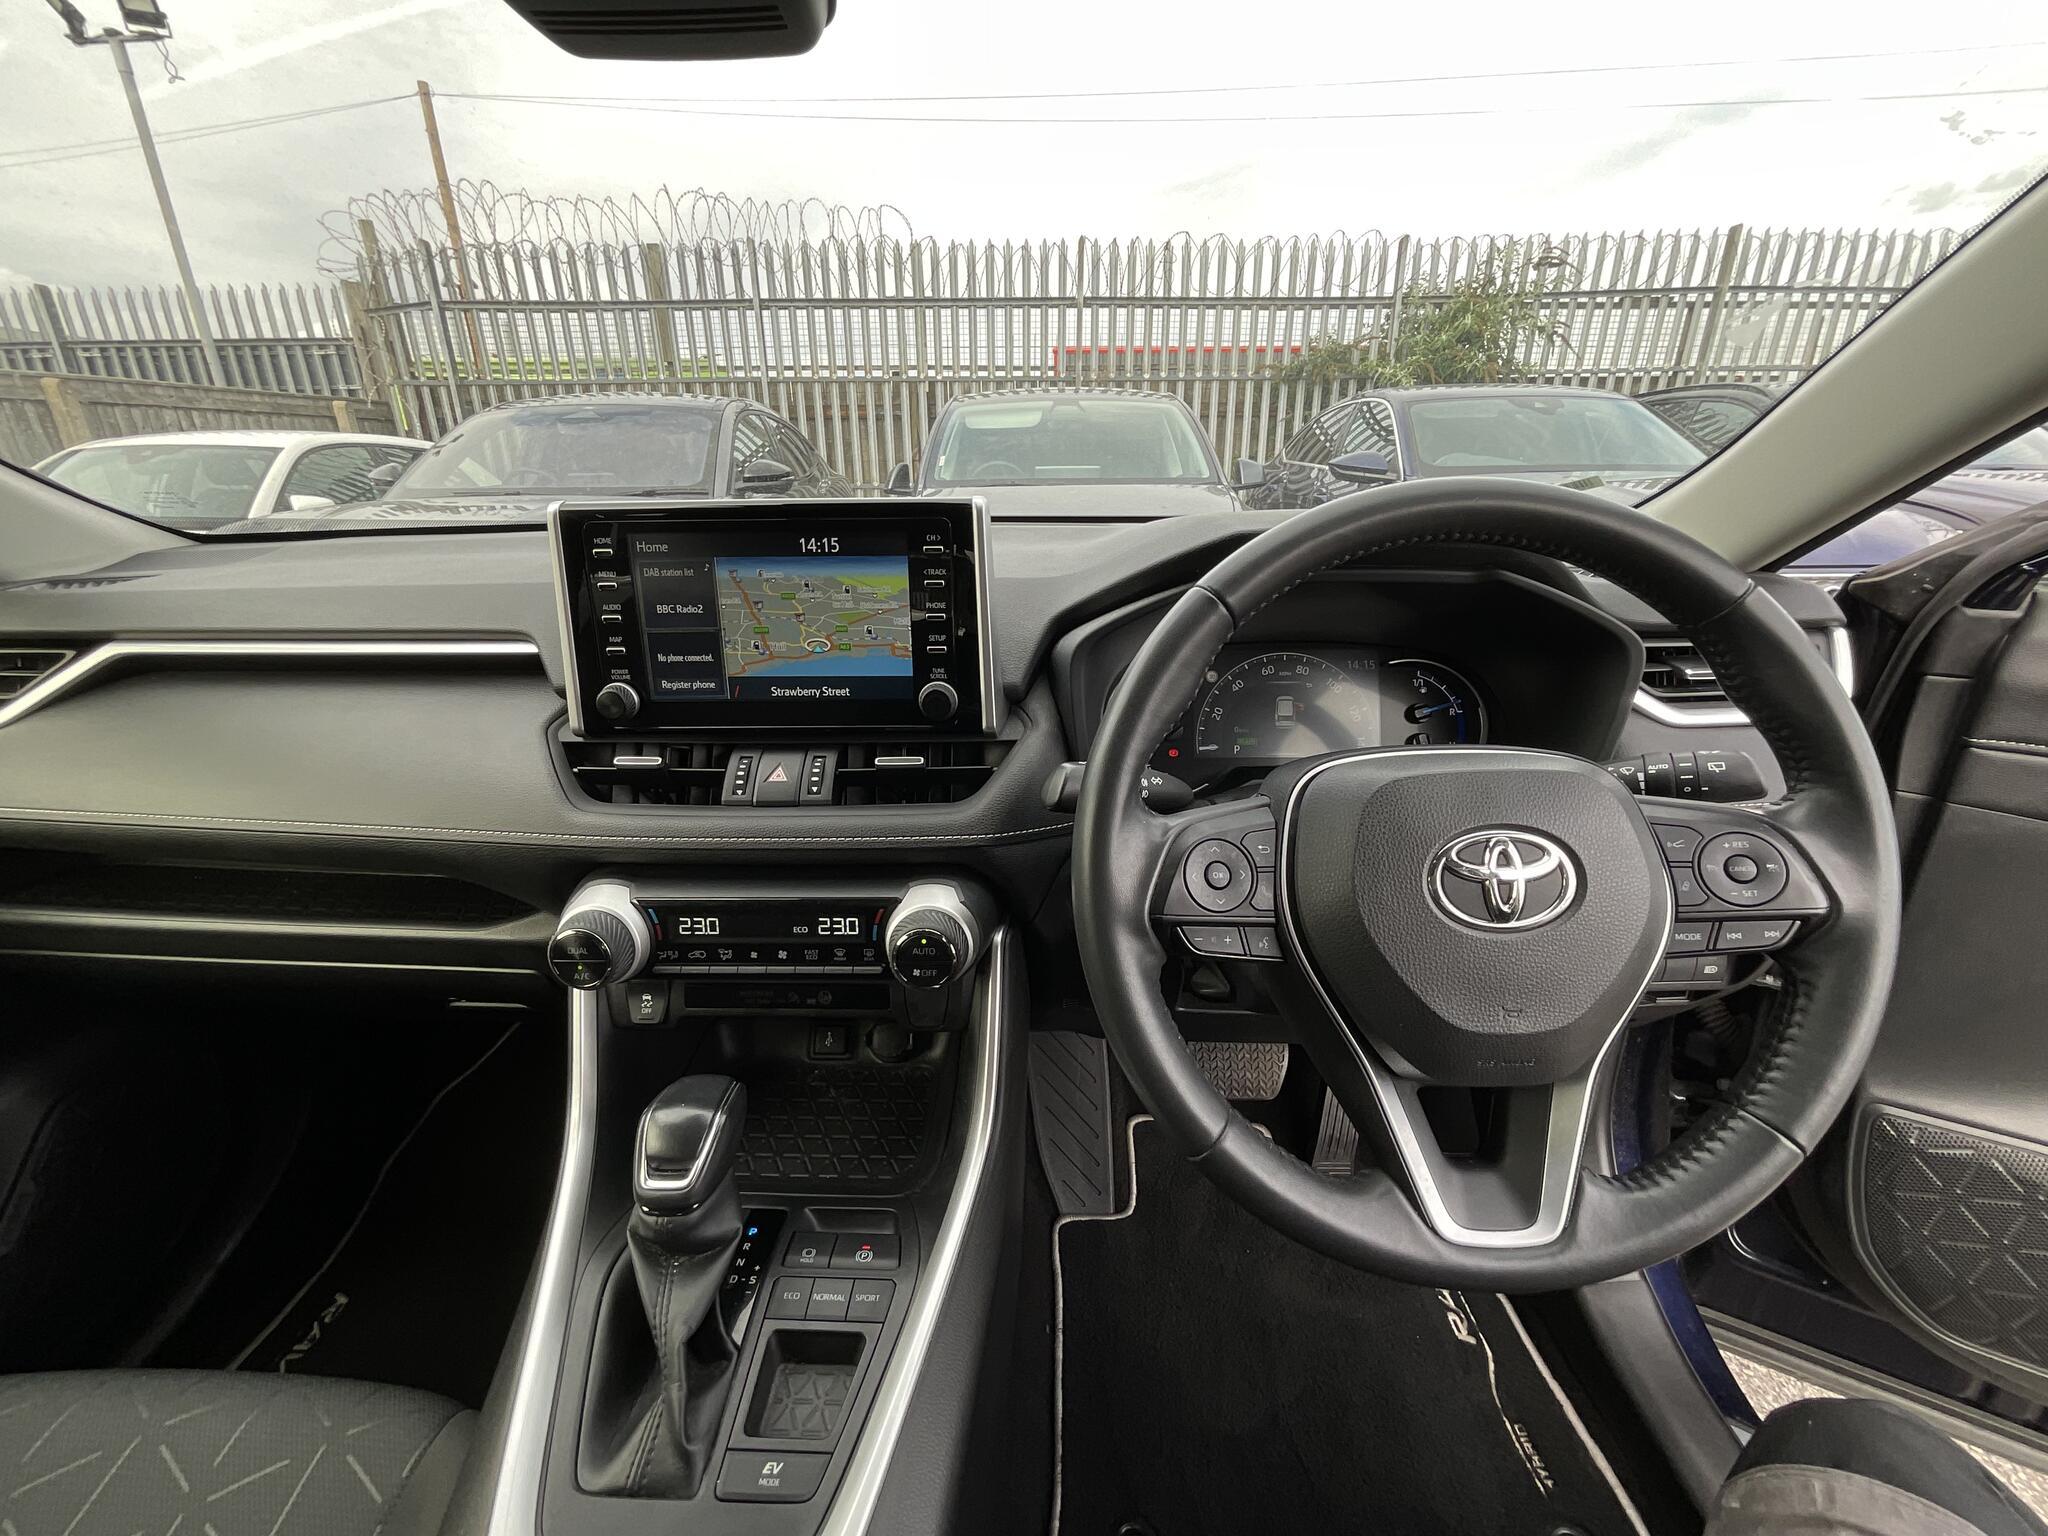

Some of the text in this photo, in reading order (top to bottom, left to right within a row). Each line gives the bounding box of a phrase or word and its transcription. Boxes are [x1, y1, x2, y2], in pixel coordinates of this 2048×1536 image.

[636, 541, 668, 552] Home
[799, 537, 840, 553] 14:15
[643, 568, 694, 577] DAB station list
[656, 605, 675, 614] BBC
[658, 654, 714, 663] No phone connected.
[1348, 660, 1376, 669] 14:15
[1261, 665, 1275, 676] 60
[1296, 665, 1309, 675] 80
[662, 681, 716, 690] Register phone
[1232, 680, 1244, 692] 40
[1326, 678, 1342, 694] 100
[771, 686, 850, 698] Strawberry Street
[1212, 707, 1223, 720] 20
[1349, 705, 1361, 722] 120
[1449, 708, 1456, 716] R
[1234, 745, 1241, 754] P
[679, 917, 719, 935] 23.0
[818, 917, 858, 935] 23.0
[1674, 932, 1702, 940] MODE
[749, 1227, 758, 1236] P
[743, 1242, 751, 1250] R
[736, 1258, 746, 1266] N
[729, 1275, 738, 1284] D
[748, 1276, 757, 1284] S
[813, 1293, 846, 1301] NORMAL
[762, 1462, 784, 1474] EV
[758, 1478, 780, 1486] MODE
